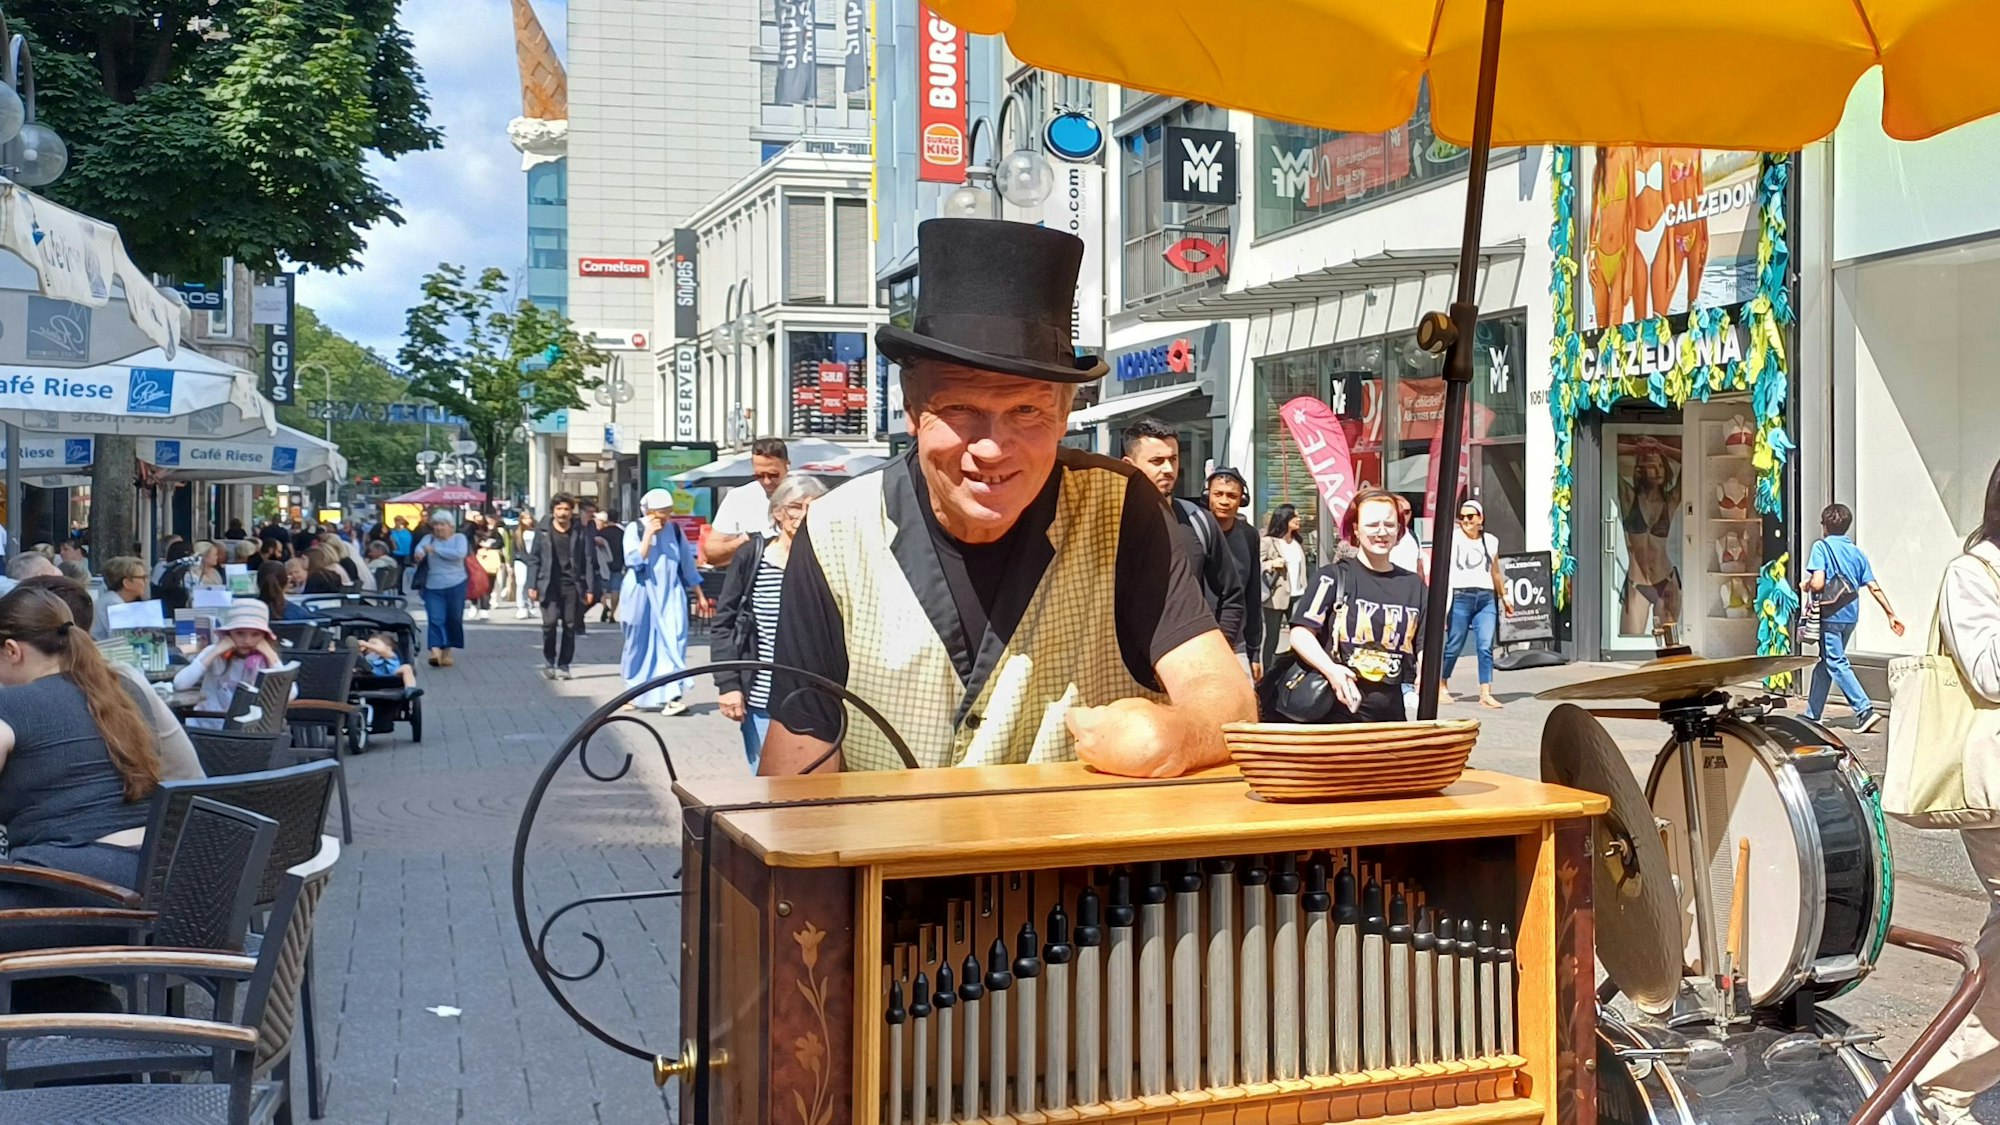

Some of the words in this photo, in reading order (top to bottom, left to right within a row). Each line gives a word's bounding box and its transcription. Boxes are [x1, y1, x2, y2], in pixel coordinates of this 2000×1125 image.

[928, 10, 957, 109] BURG
[927, 136, 959, 145] BURGER
[927, 144, 959, 156] KING
[581, 260, 646, 273] Cornelsen
[676, 261, 697, 306] snipes
[272, 341, 288, 401] GUYS
[1117, 344, 1169, 382] NORDSEE
[44, 378, 114, 399] Riese
[190, 448, 221, 460] Café
[226, 449, 263, 463] Riese
[1504, 577, 1547, 606] 10%
